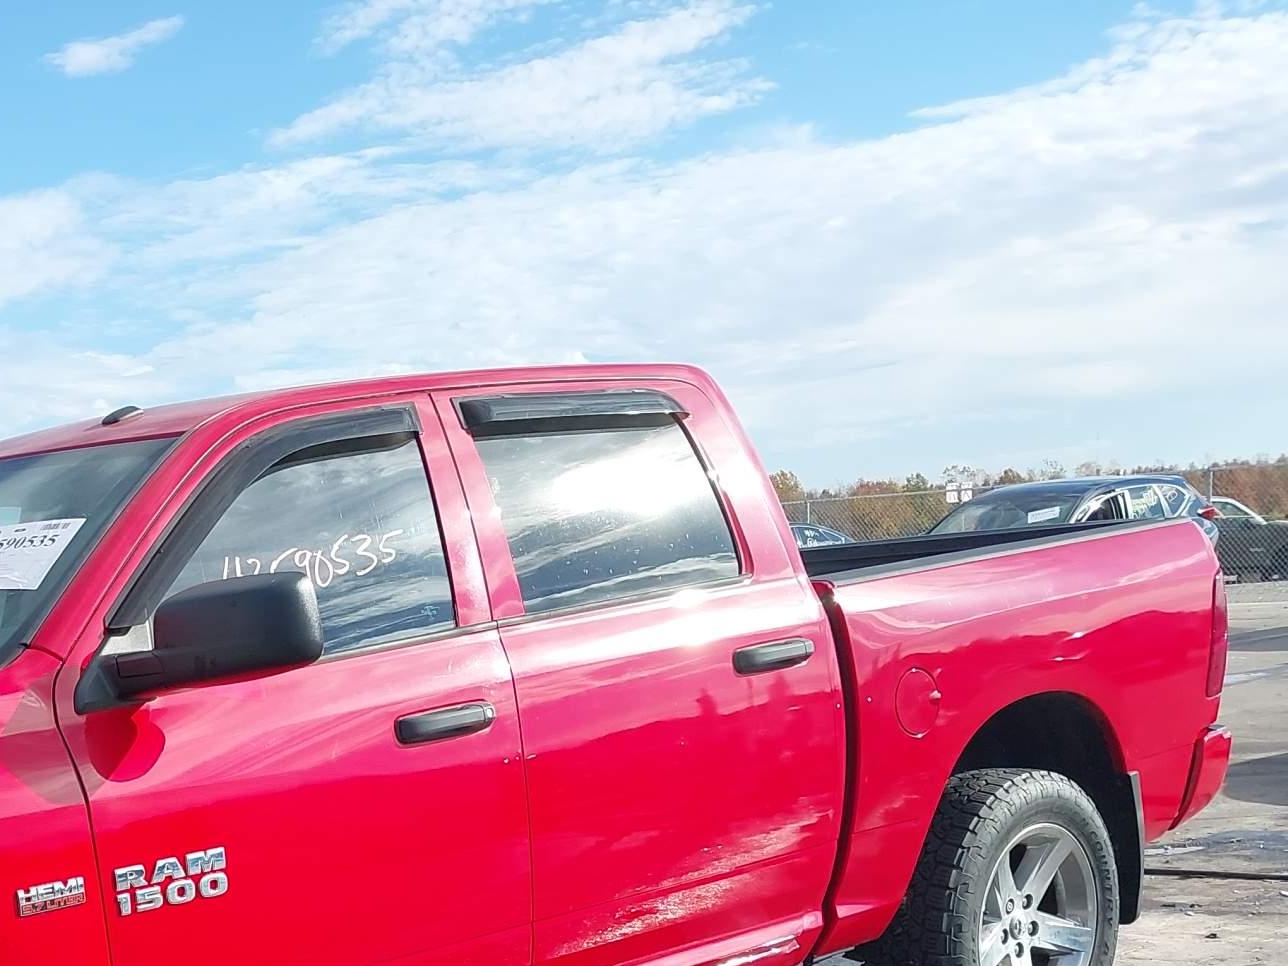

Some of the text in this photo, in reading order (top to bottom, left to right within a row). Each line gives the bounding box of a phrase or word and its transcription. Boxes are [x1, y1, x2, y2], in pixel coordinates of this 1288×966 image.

[17, 876, 84, 905] HEMI
[114, 846, 227, 892] RAM
[116, 871, 229, 916] 1500
